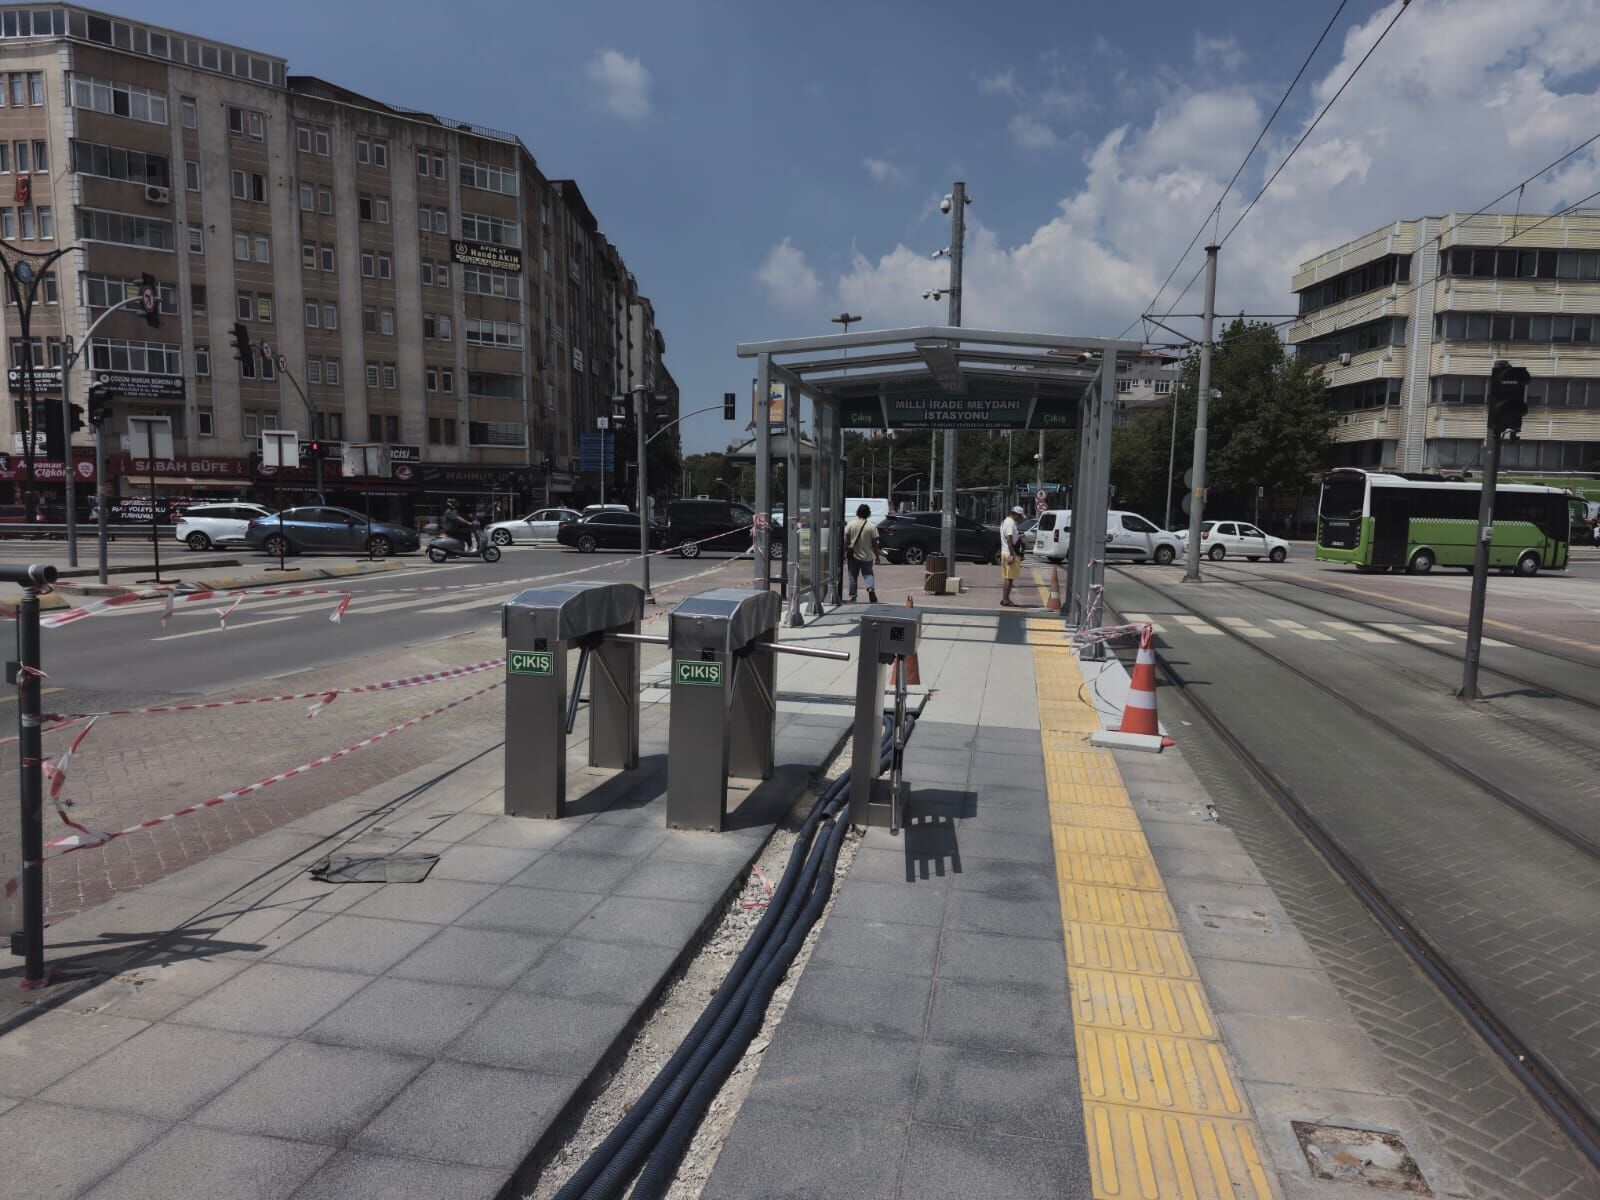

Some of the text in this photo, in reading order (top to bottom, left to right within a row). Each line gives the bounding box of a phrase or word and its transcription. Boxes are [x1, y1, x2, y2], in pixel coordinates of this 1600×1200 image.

[470, 248, 497, 260] Hande
[480, 245, 507, 254] AVUKAT
[895, 398, 1020, 409] MİLLİ İRADE MEYDANI
[850, 413, 873, 424] Çıkış
[924, 410, 990, 421] İSTASYONU
[1043, 413, 1067, 424] Çıkış
[191, 459, 229, 472] BÜFE
[512, 655, 550, 672] ÇIKIŞ
[680, 664, 719, 682] ÇIKIŞ
